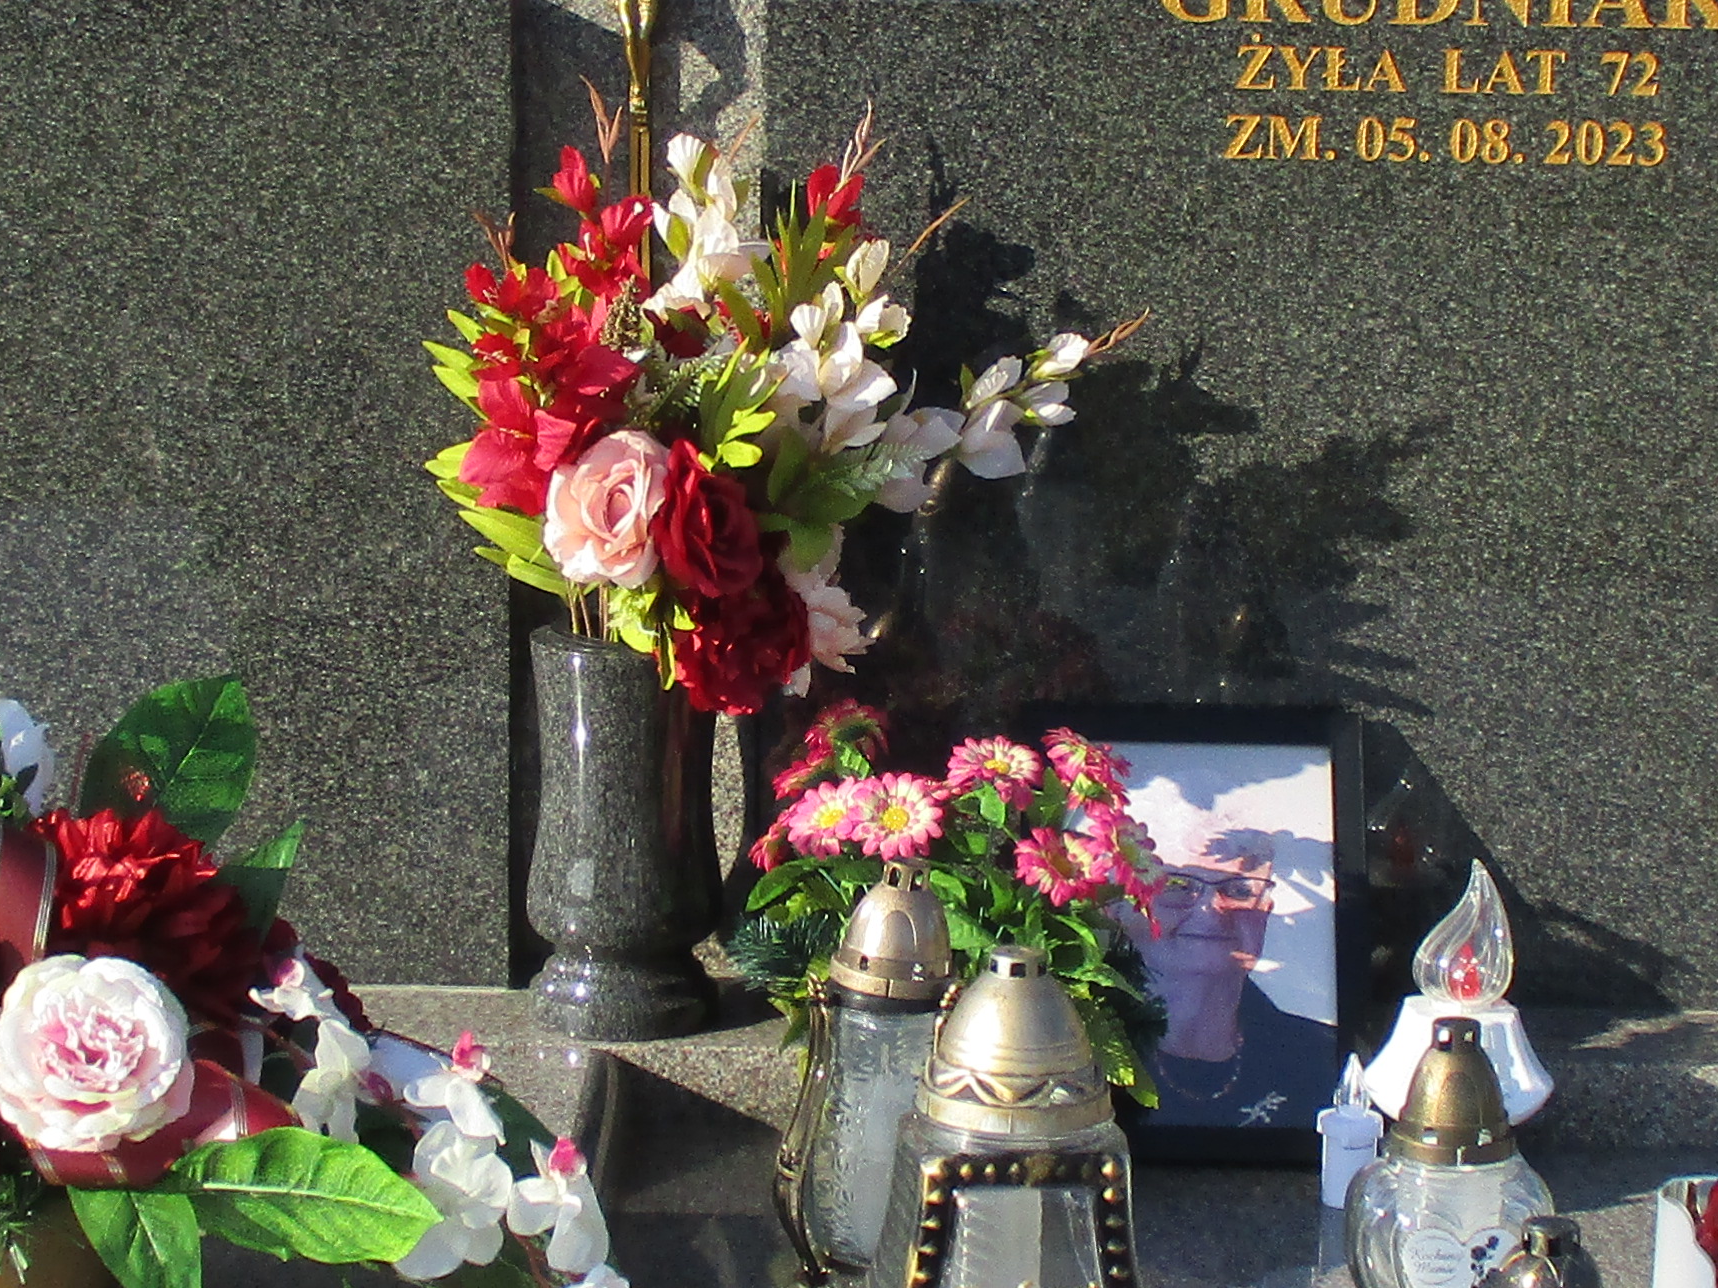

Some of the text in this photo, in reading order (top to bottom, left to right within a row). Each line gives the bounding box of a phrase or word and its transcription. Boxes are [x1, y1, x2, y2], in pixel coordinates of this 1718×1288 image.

[1236, 32, 1660, 98] ŻYŁA LAT 72
[1222, 115, 1668, 167] ZM. 05. 08. 2023
